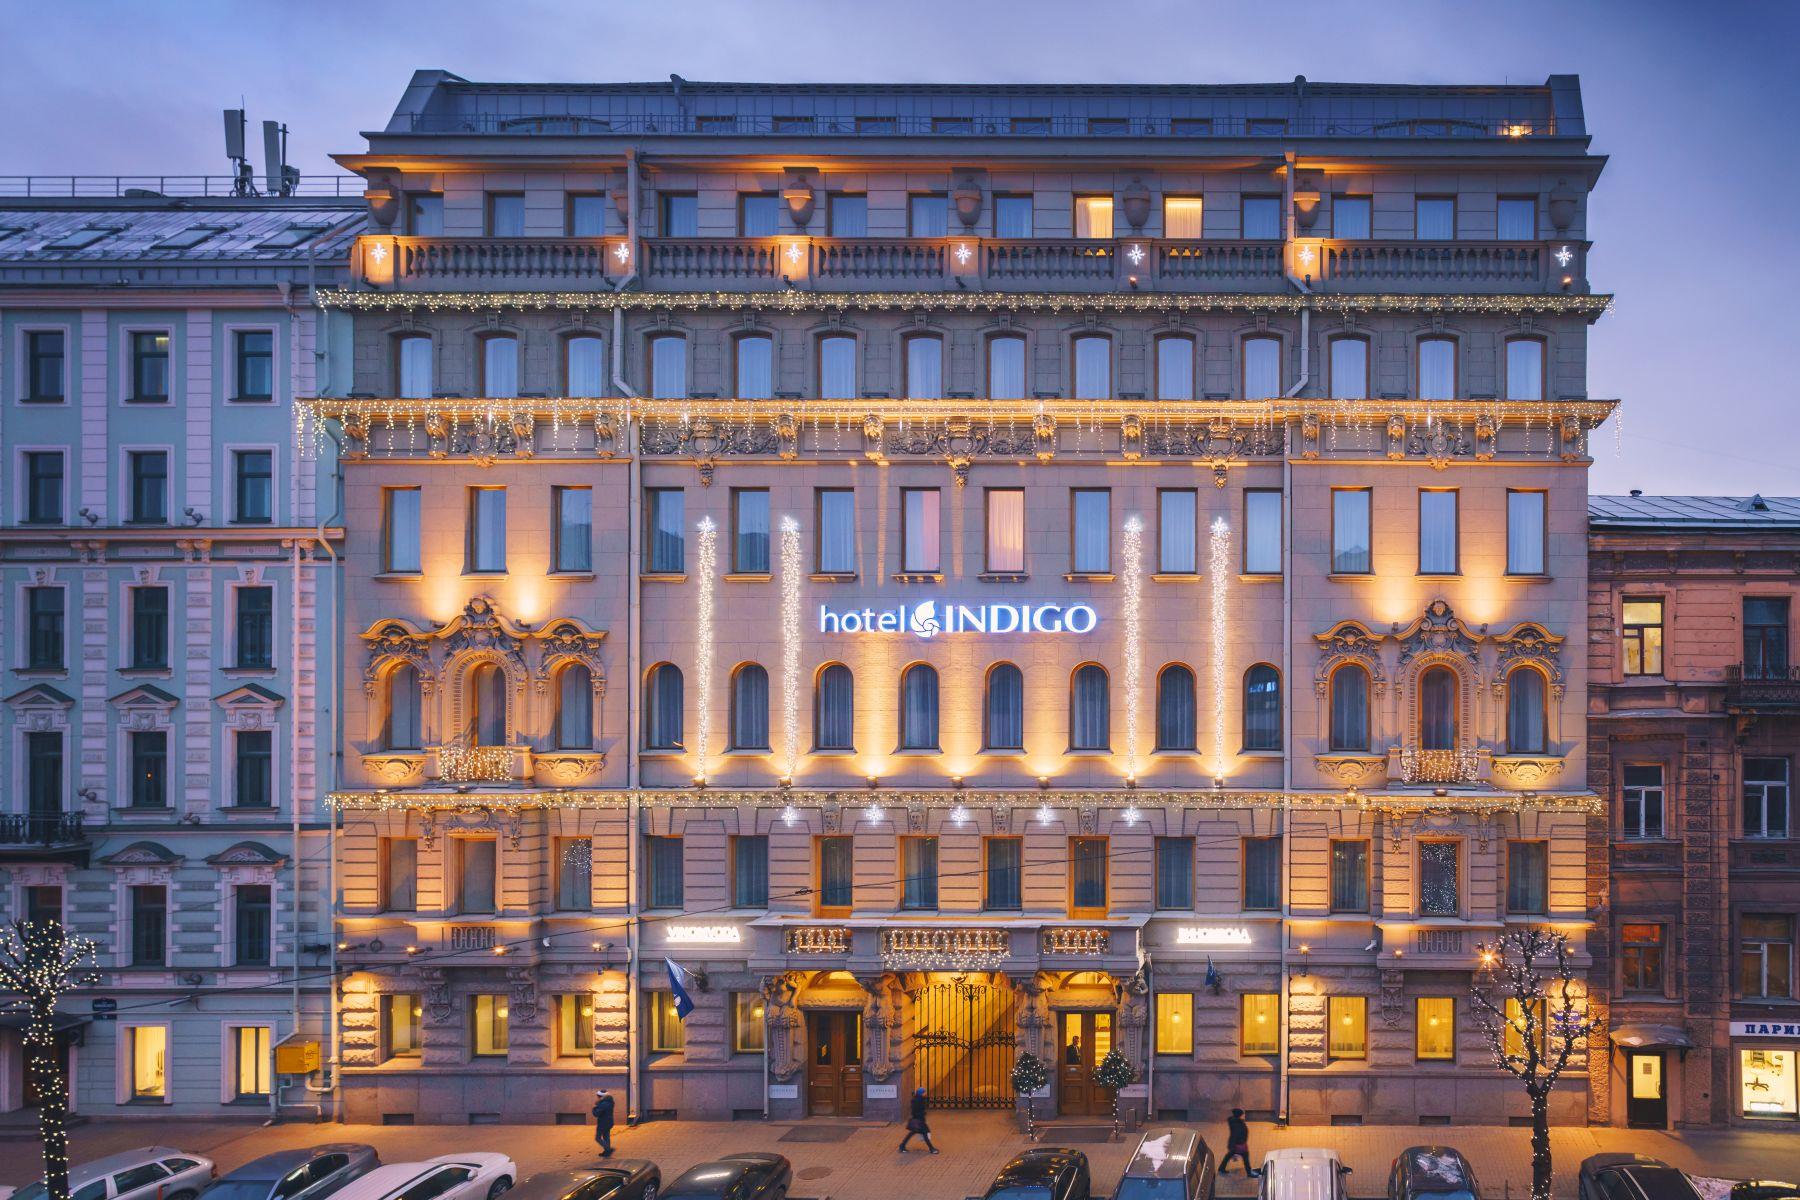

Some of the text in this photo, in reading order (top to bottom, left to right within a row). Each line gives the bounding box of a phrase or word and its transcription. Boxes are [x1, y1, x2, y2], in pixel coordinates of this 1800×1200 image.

[820, 605, 1097, 634] hotel INDIGO
[1745, 1024, 1800, 1035] ПАРИ
